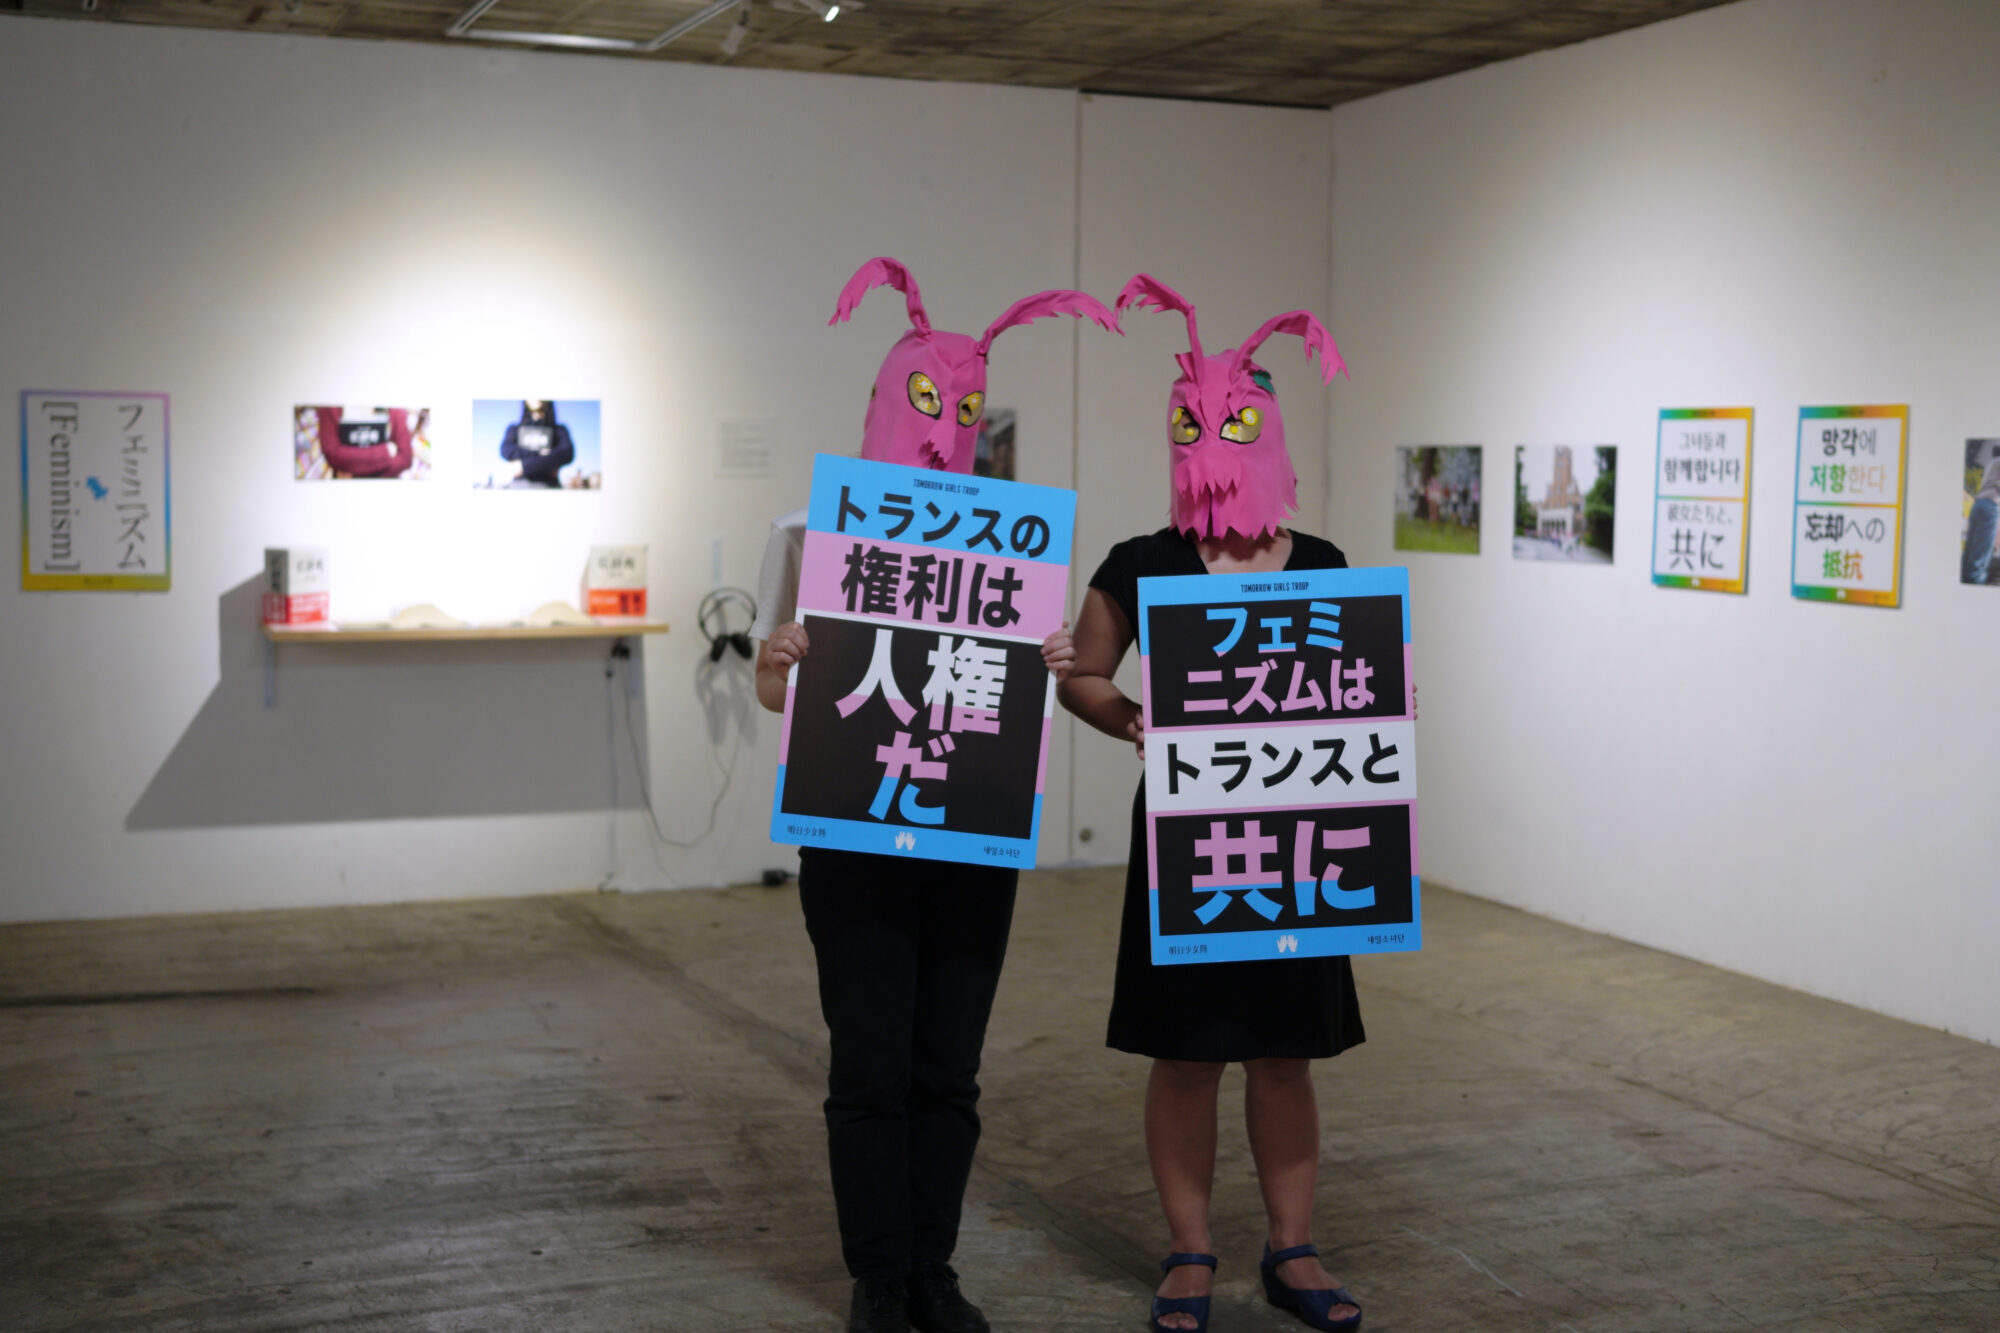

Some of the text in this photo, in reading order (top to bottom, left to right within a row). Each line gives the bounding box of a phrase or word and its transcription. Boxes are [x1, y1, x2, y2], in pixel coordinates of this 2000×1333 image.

[1821, 426, 1877, 456] 망각에
[42, 402, 81, 571] [Feminism]
[115, 404, 150, 570] フェミニズム
[913, 478, 980, 496] TOMORROW GIRLS TROOP
[1809, 463, 1887, 494] 저항한다
[836, 485, 1050, 558] トランスの
[1668, 528, 1724, 571] 共に
[1805, 513, 1885, 543] 忘却への
[841, 543, 1024, 628] 権利は
[1240, 581, 1309, 593] TOMORROW GIRLS TROOP
[1822, 550, 1864, 581] 抵抗
[1205, 601, 1344, 658] フェミ
[835, 628, 1008, 735] 人権
[1183, 657, 1376, 716] ニズムは
[867, 730, 956, 825] だ
[1166, 732, 1400, 795] トランスと
[1191, 819, 1377, 926] 共に
